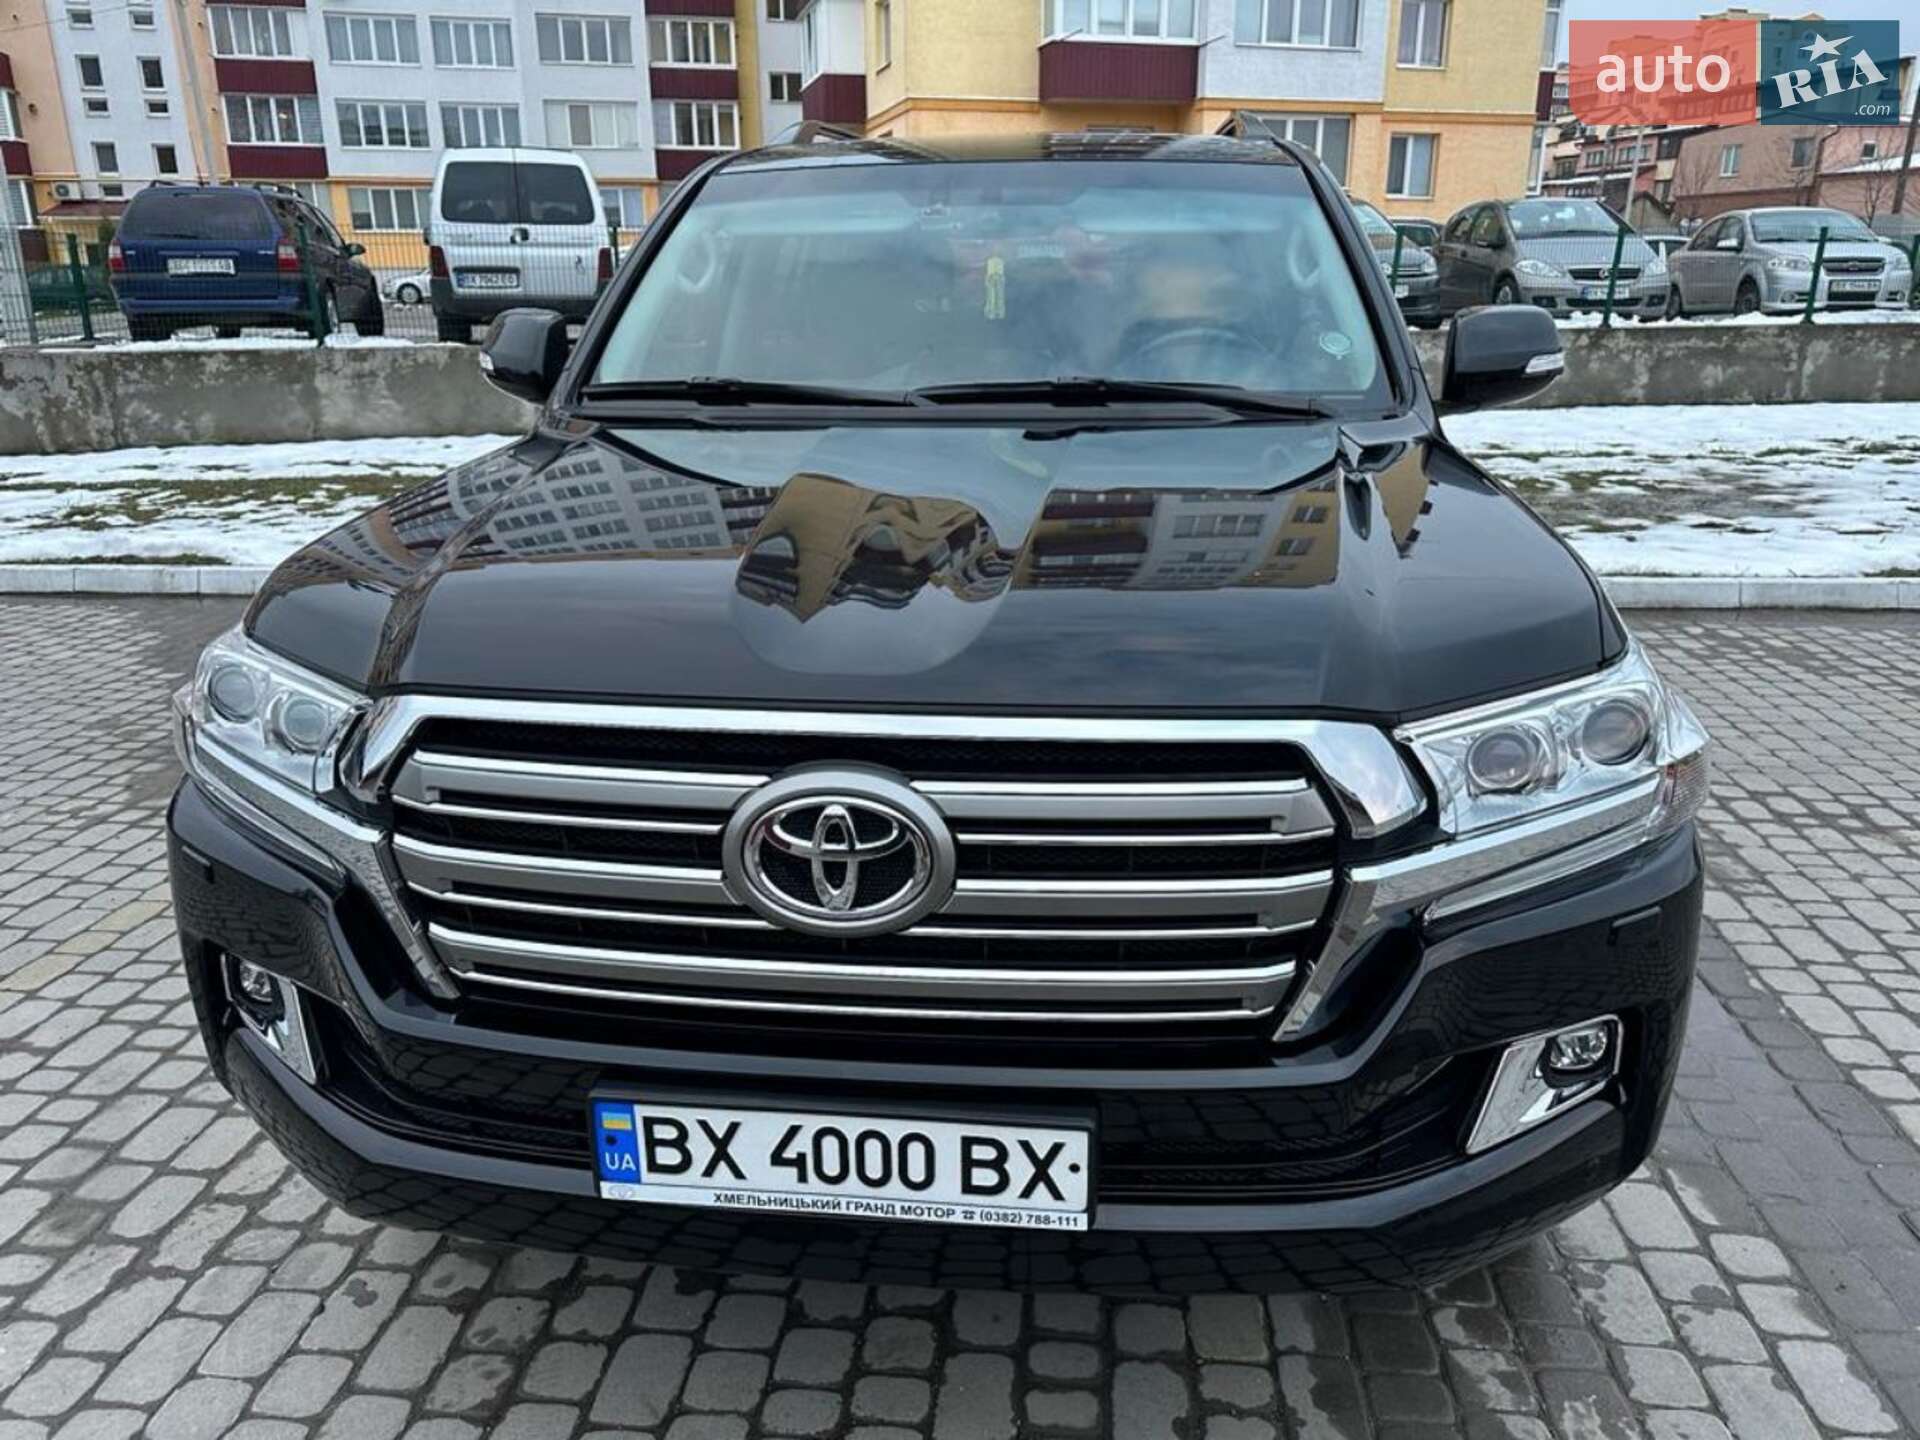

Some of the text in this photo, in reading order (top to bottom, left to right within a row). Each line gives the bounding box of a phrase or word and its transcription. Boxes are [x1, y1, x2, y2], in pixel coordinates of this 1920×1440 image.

[605, 1152, 636, 1171] UA
[642, 1116, 1066, 1201] BX 4000 BX
[713, 1193, 1078, 1227] ХМЕЛЬНИЦЬКИЙ ГРАНД МОТОР (0382) 788-111
